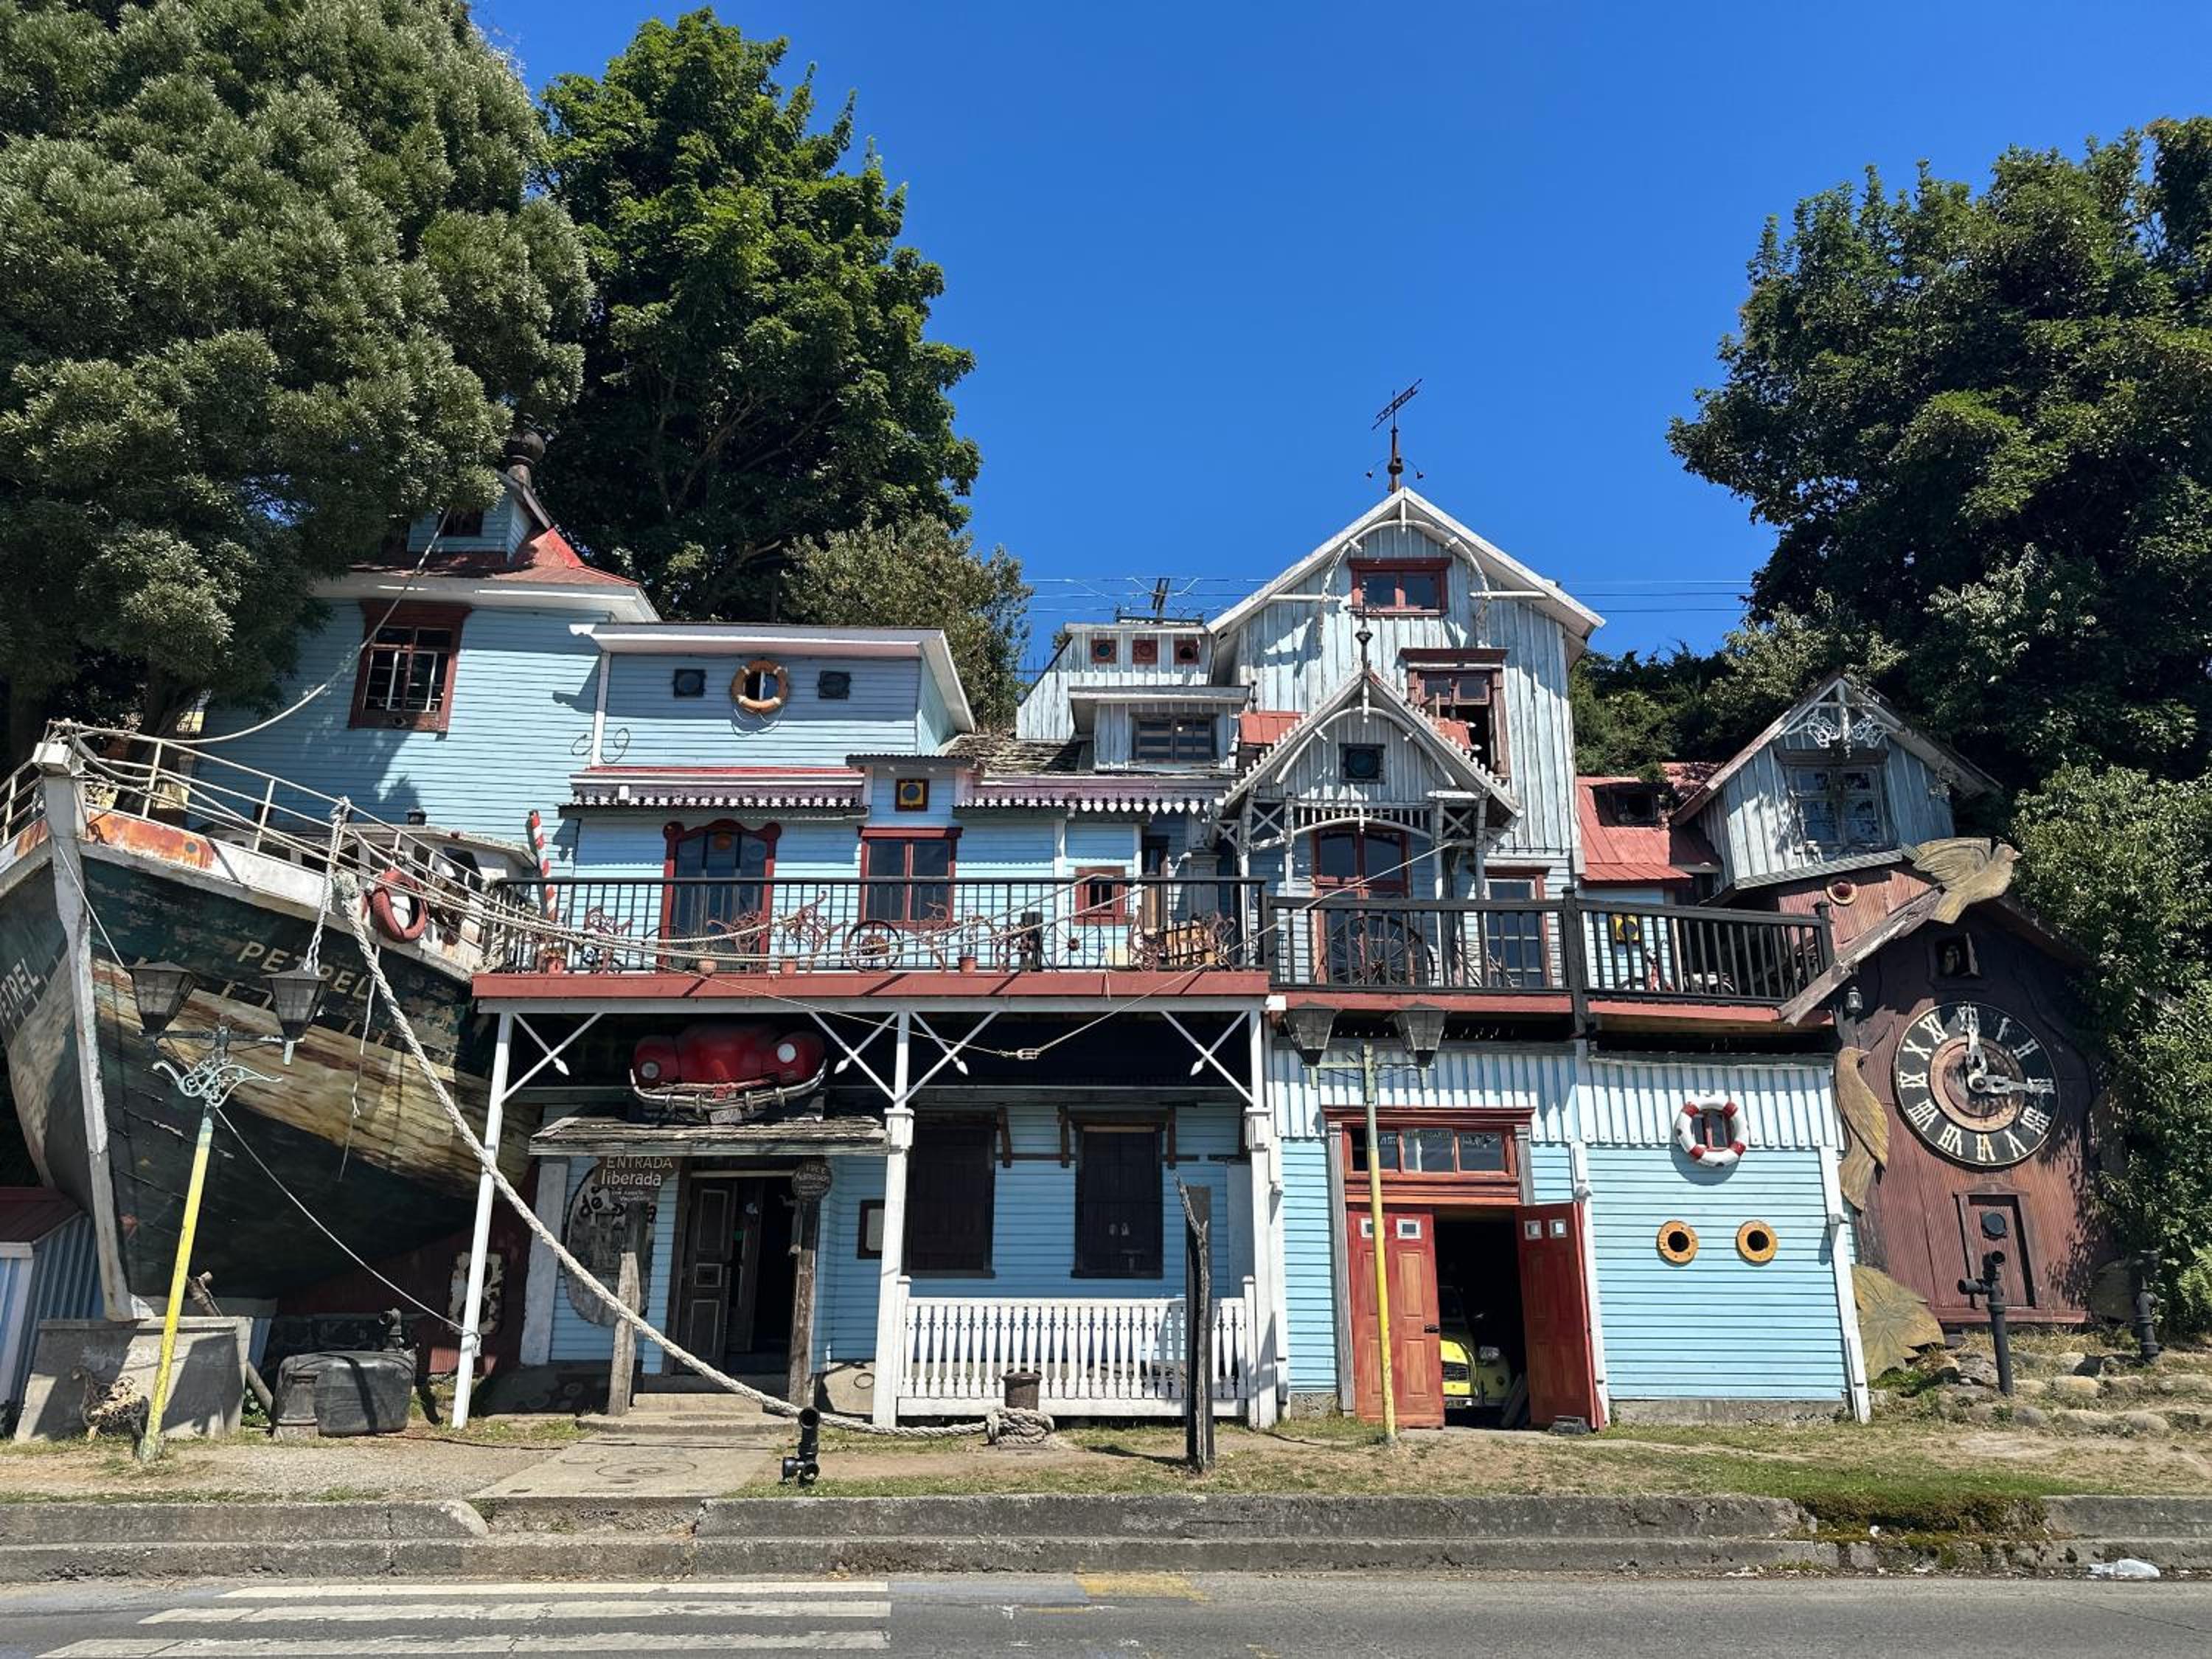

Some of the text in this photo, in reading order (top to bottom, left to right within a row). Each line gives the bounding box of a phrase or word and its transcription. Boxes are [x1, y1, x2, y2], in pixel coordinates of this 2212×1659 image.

[237, 941, 369, 1000] PEREL
[0, 958, 40, 1026] ETREL
[1919, 1013, 1949, 1044] XI
[1902, 1039, 1933, 1061] X
[2012, 1037, 2040, 1060] II
[1899, 1071, 1928, 1088] IX
[1907, 1098, 1939, 1133] VIII
[1937, 1122, 1964, 1157] VII
[1975, 1133, 1996, 1162] VI
[2004, 1130, 2028, 1158] V
[607, 1157, 673, 1169] ENTRADA
[601, 1169, 662, 1186] liberada
